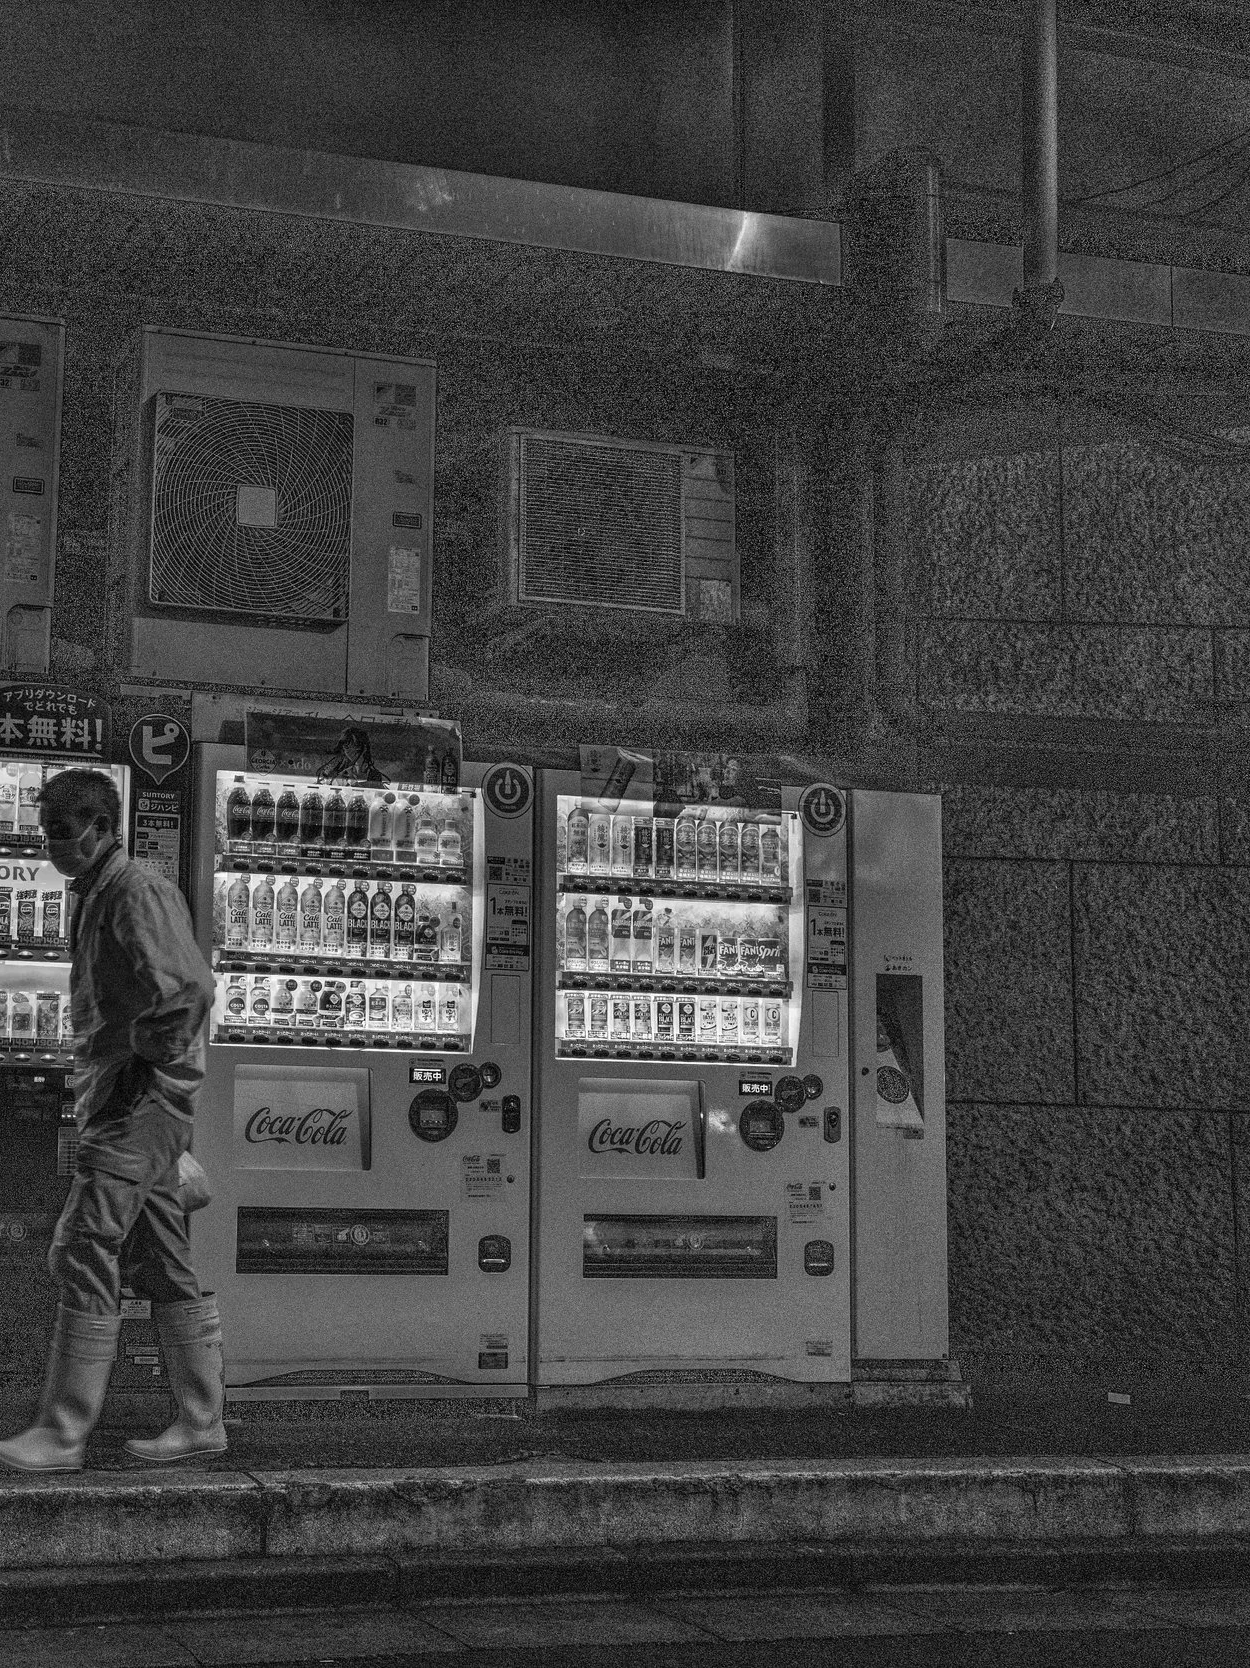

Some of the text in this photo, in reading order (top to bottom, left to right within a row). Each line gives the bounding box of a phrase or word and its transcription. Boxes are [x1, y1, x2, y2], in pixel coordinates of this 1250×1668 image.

[3, 688, 97, 709] アプリダウンロード
[23, 701, 78, 716] でどれでも
[141, 791, 175, 800] SUNTORY
[658, 936, 674, 946] FANT
[680, 937, 695, 947] FANT
[719, 945, 738, 955] FANT
[740, 946, 759, 957] FANT
[412, 1071, 442, 1081] 販売中
[742, 1083, 769, 1094] 販売中
[244, 1107, 354, 1145] Coca-Cola
[588, 1118, 688, 1155] Coca-Cola
